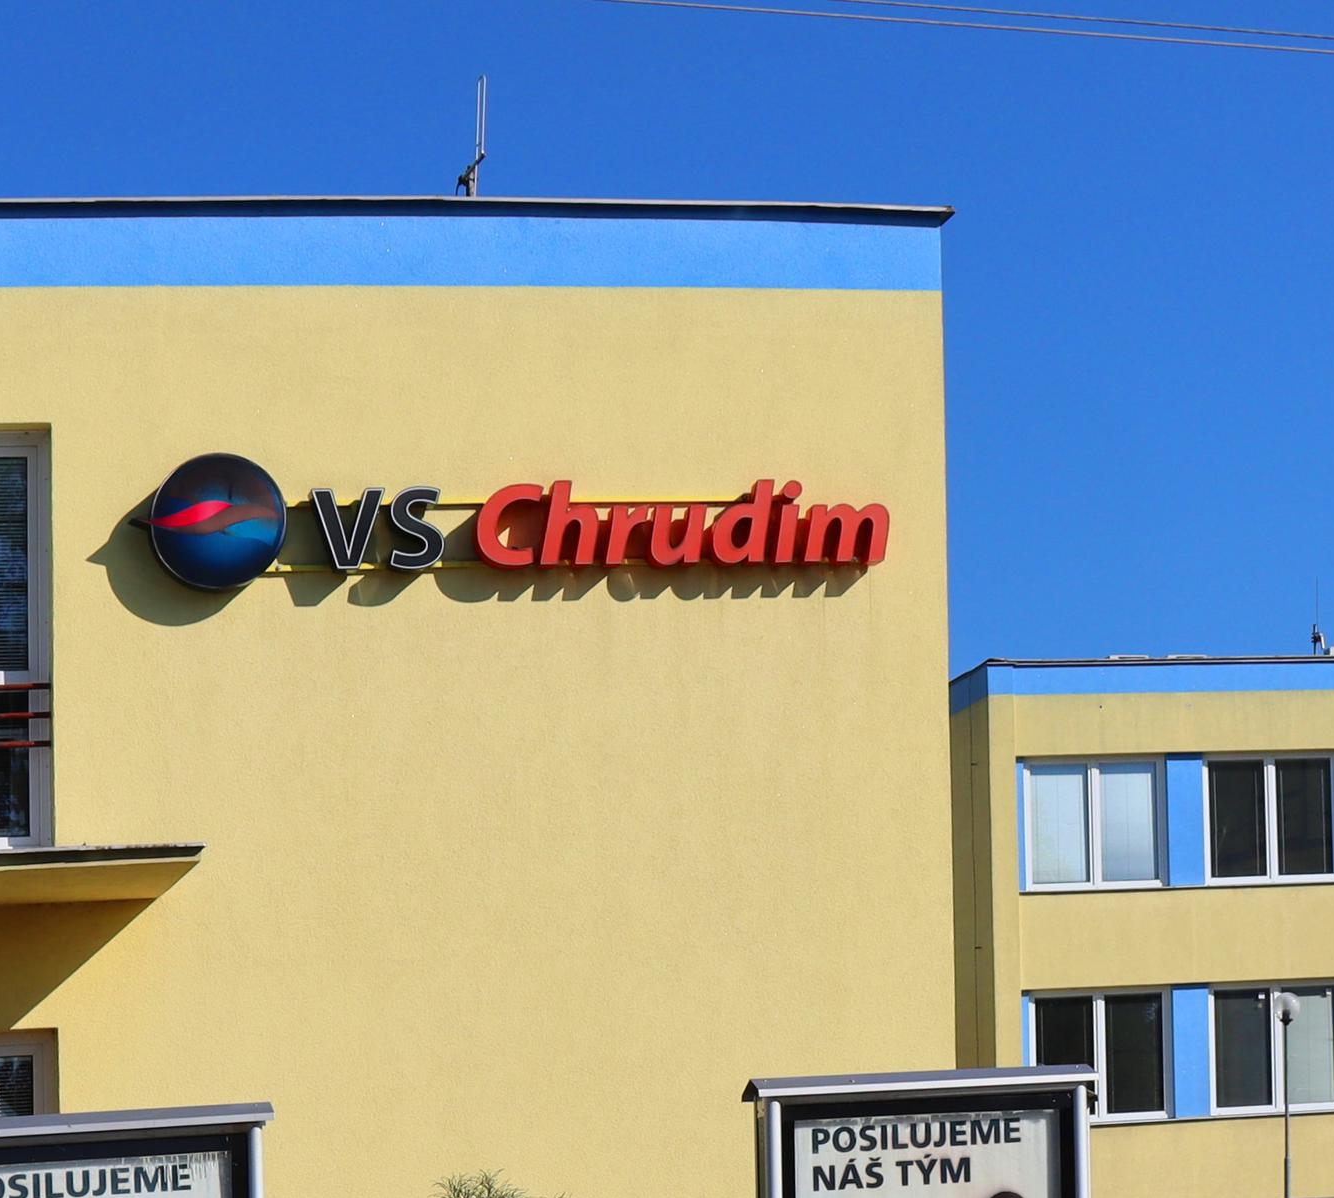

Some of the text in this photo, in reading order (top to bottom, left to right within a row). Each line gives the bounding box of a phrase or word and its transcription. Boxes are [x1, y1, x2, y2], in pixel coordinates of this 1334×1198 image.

[309, 479, 890, 571] VS Chrudim
[812, 1117, 1021, 1154] POSILUJEME
[813, 1154, 971, 1192] NÁŠ TÝM
